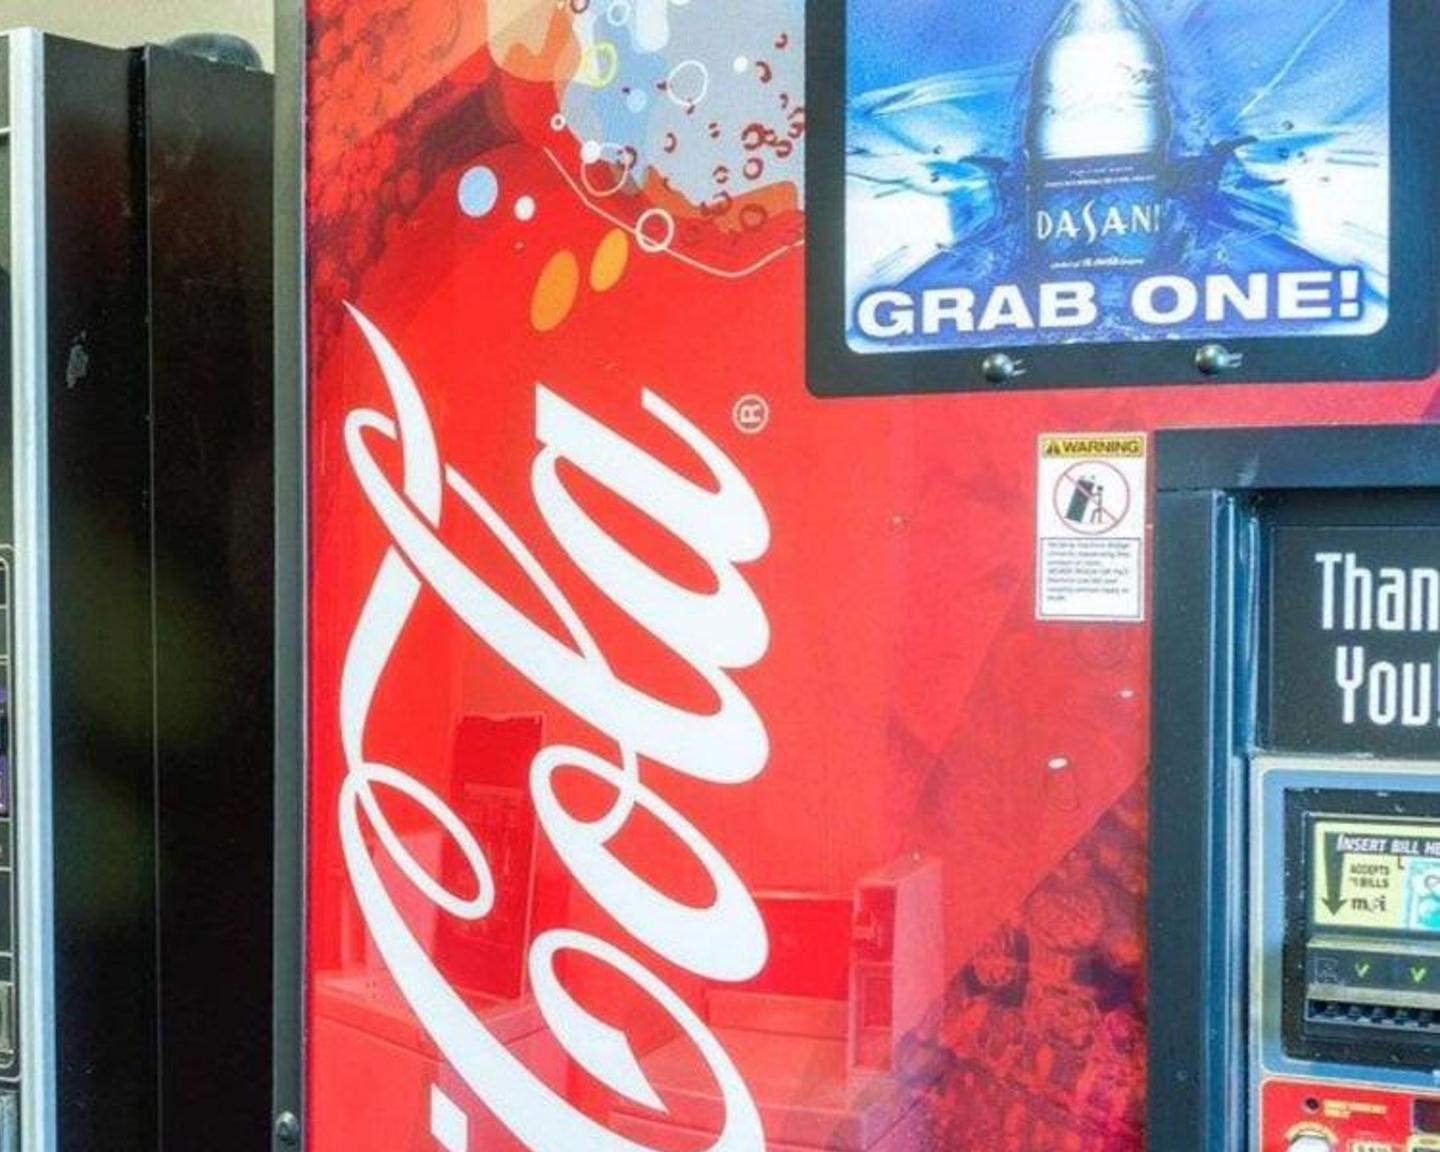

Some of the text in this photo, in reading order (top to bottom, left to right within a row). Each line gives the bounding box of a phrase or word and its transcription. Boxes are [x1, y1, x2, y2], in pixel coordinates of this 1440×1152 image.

[1036, 199, 1160, 246] DASANI
[858, 269, 1360, 338] GRAB ONE!
[1062, 440, 1139, 454] WARNING
[1337, 834, 1387, 851] INSERT
[1390, 838, 1420, 854] BILL
